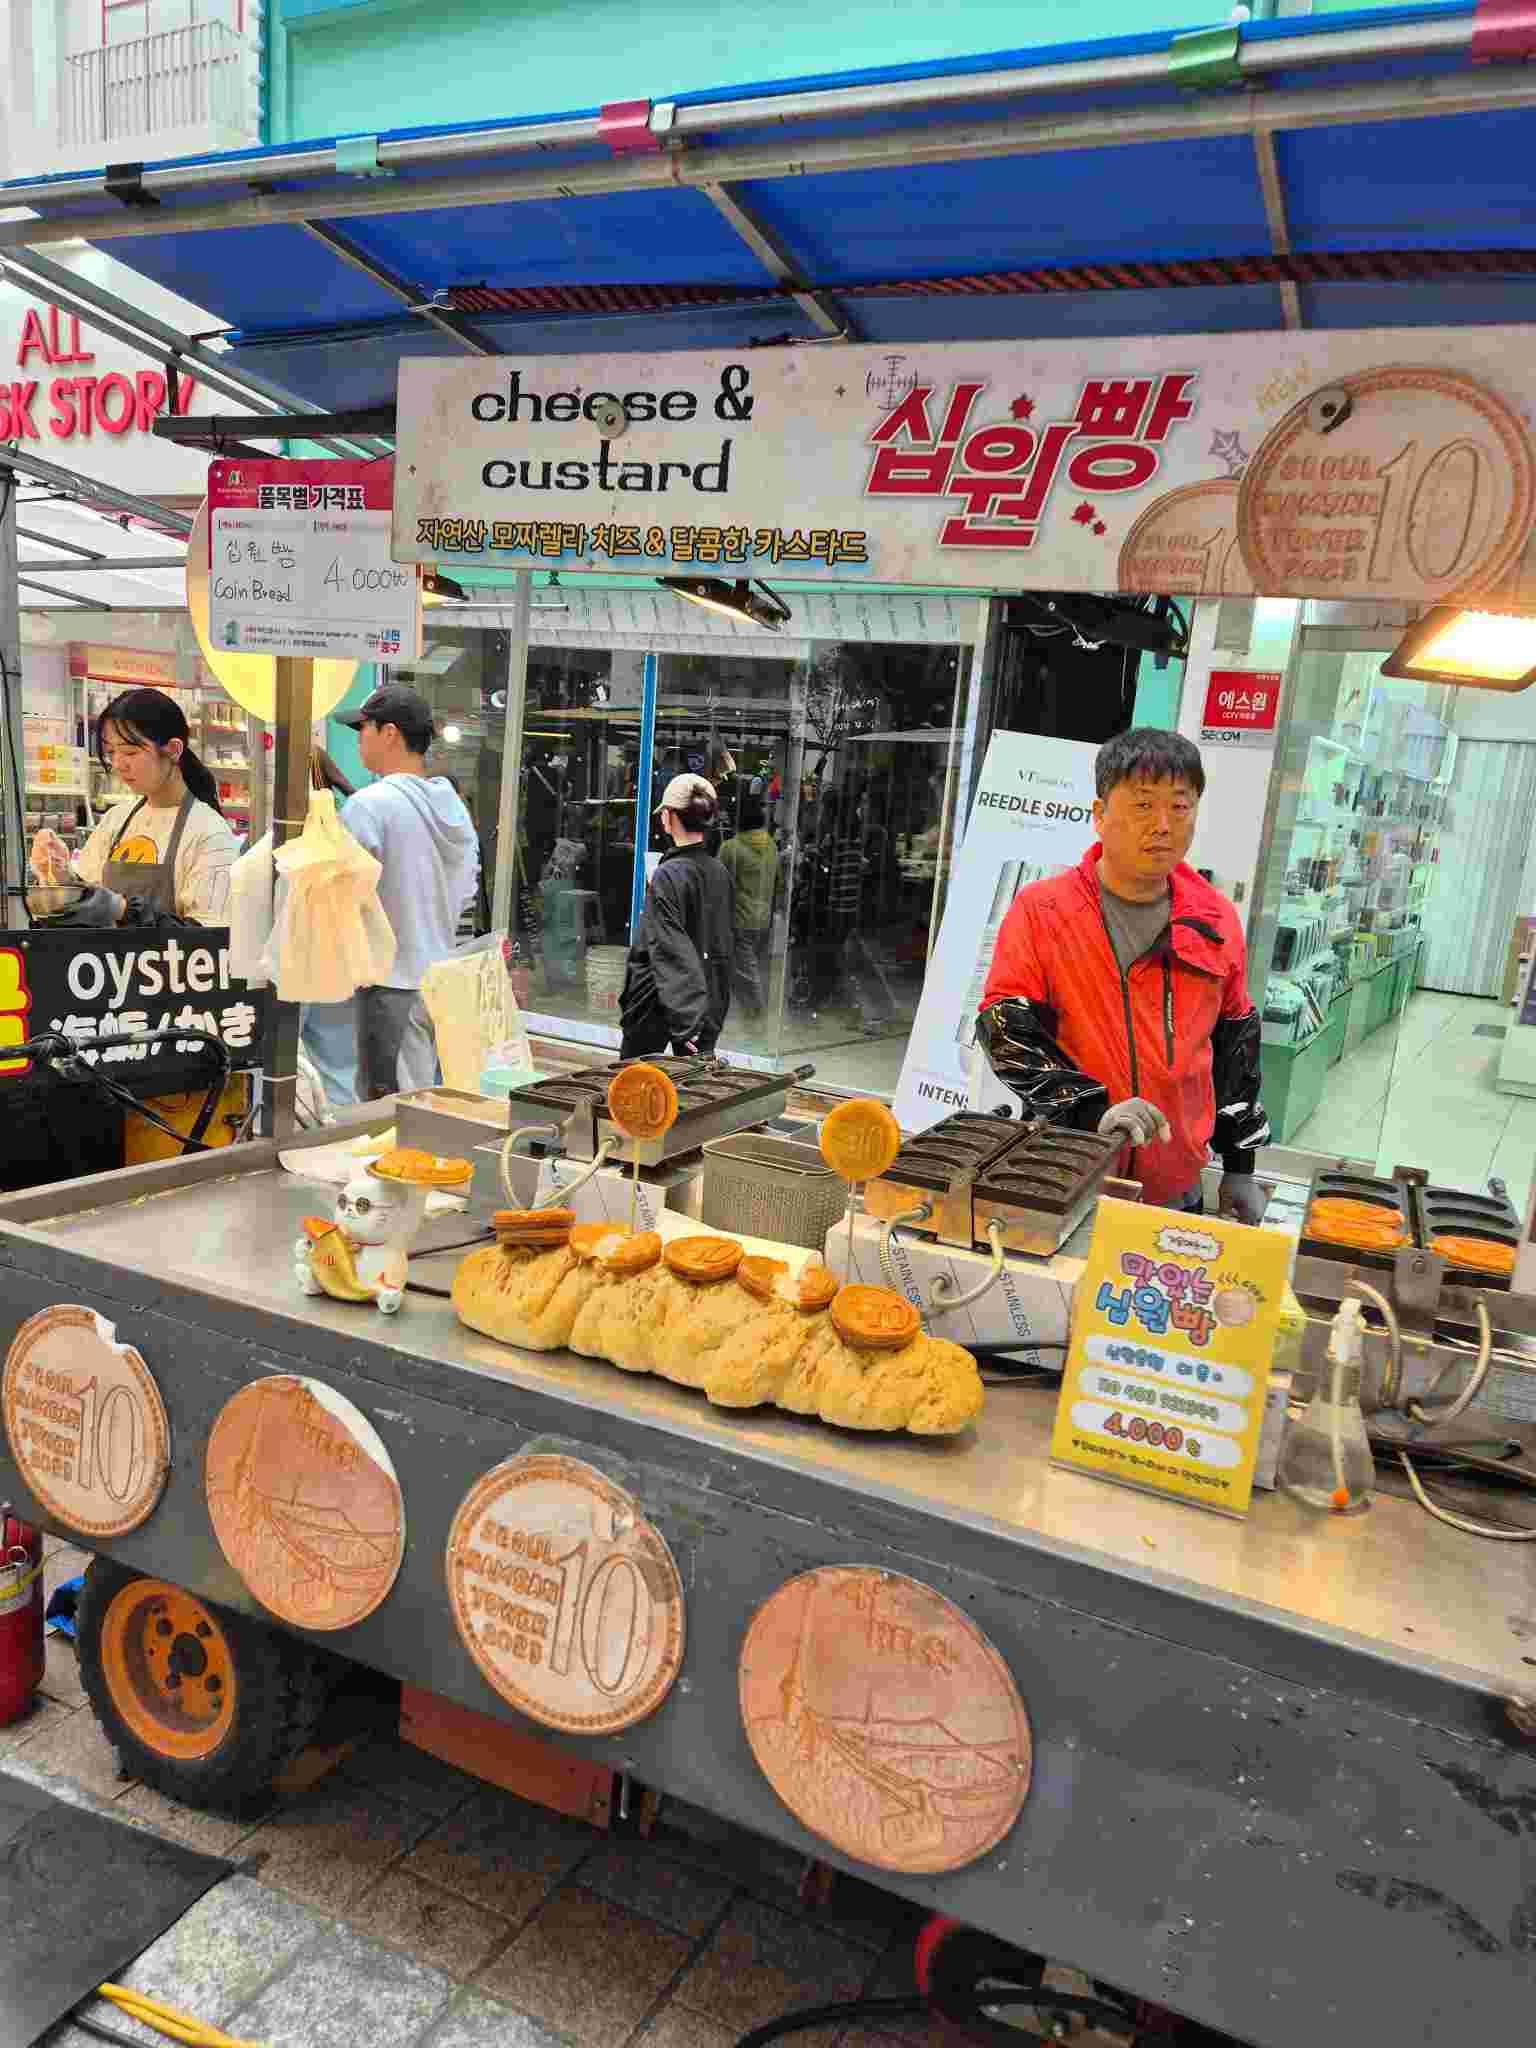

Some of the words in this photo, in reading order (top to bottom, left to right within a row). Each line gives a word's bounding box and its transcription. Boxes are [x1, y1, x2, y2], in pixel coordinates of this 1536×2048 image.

[16, 304, 96, 368] ALL
[471, 370, 698, 423] cheese
[713, 364, 755, 423] &
[481, 438, 733, 494] custard
[865, 370, 1200, 550] 십원빵
[416, 519, 487, 552] 자연산
[490, 521, 587, 557] 모짜렐라
[591, 523, 642, 559] 치즈
[644, 528, 667, 557] &
[670, 527, 752, 564] 달콤한
[753, 527, 868, 567] 카스타드
[214, 576, 248, 600] Coin
[1217, 690, 1268, 712] 에스원
[977, 790, 1042, 816] REEDLE
[1000, 1271, 1031, 1338] STAINLESS
[547, 1539, 655, 1698] 10
